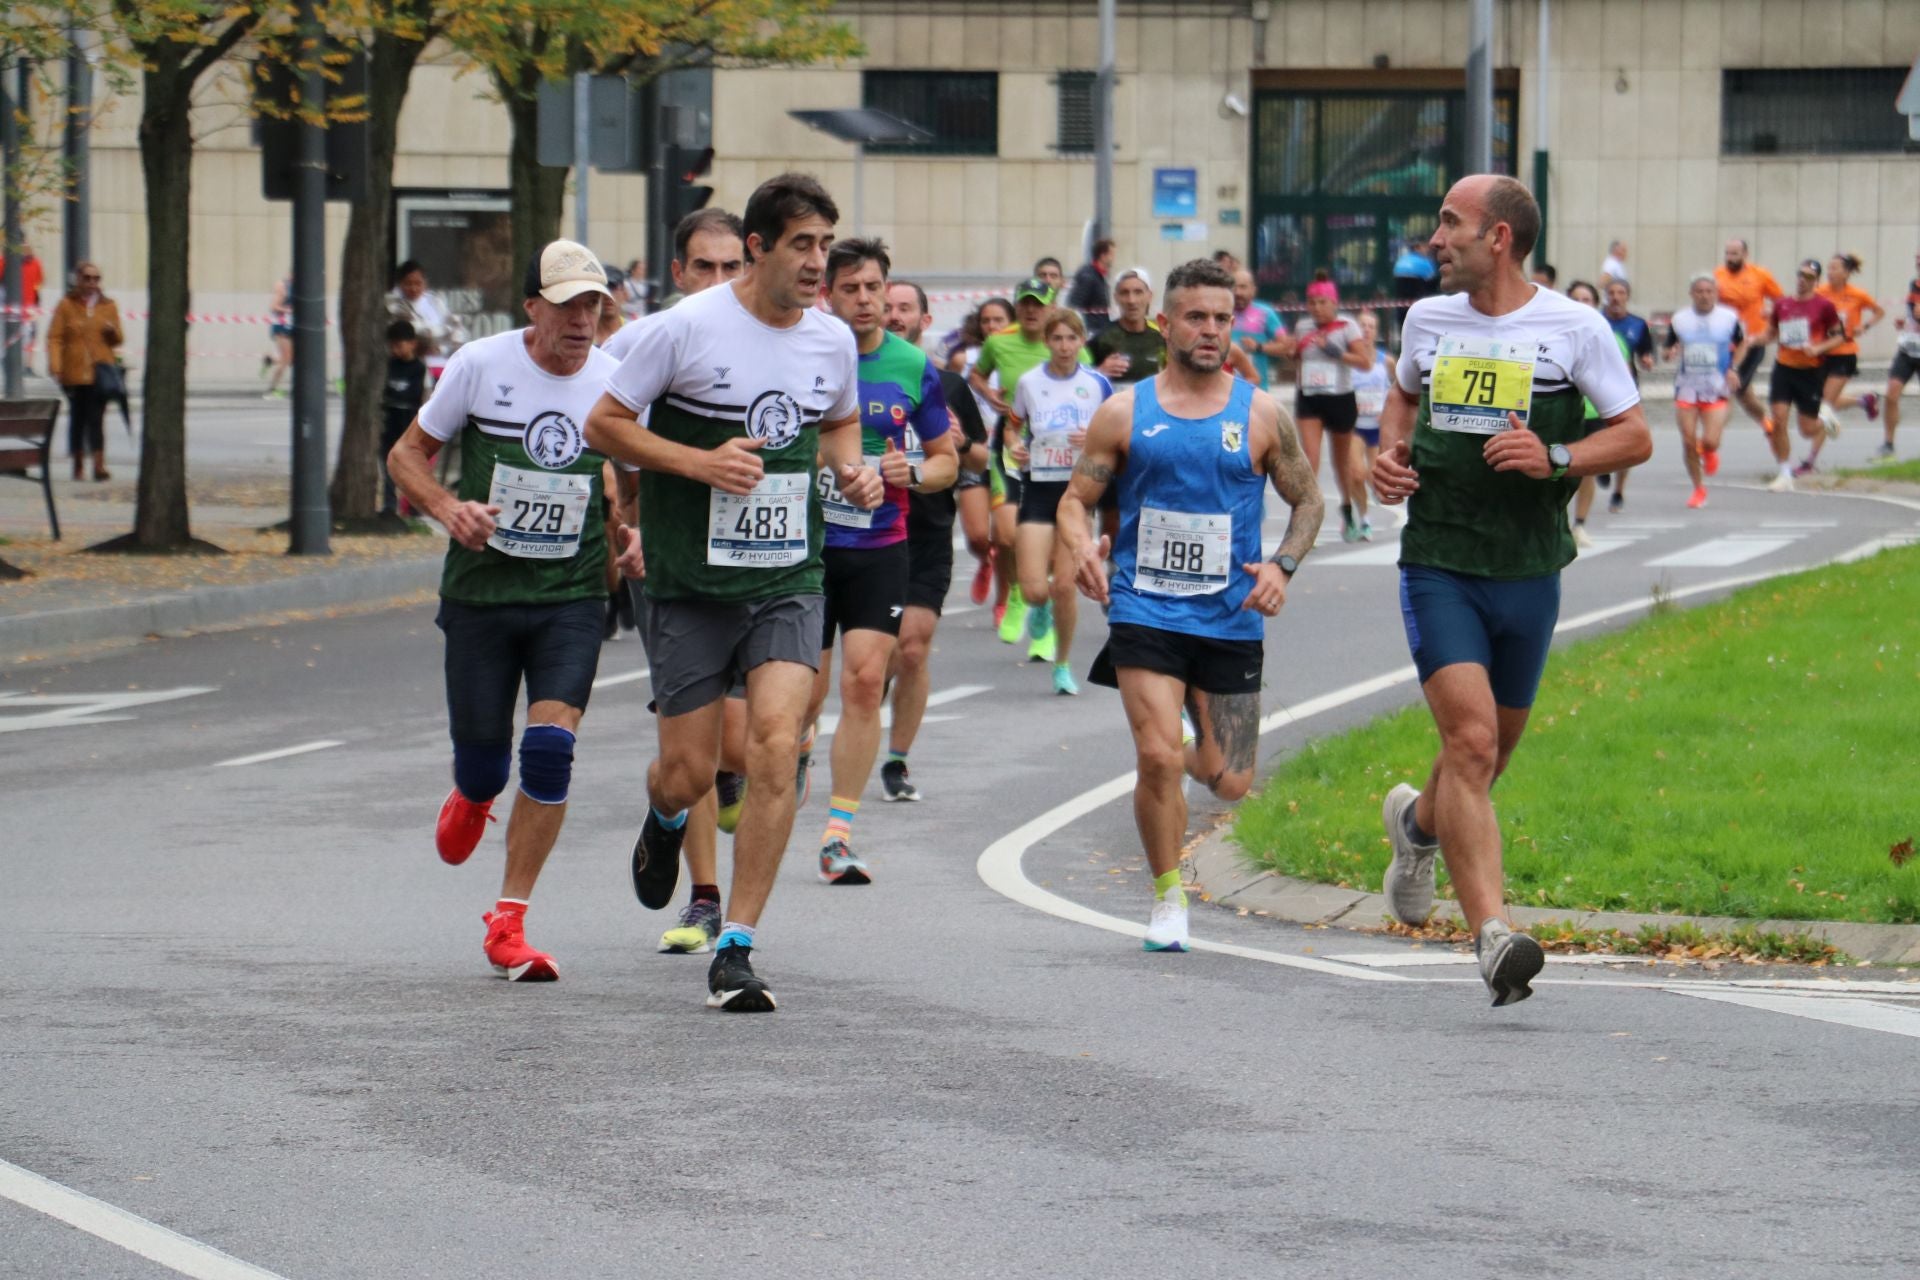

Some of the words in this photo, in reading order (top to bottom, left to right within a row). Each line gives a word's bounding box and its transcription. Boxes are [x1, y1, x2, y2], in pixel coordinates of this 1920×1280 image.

[1462, 370, 1497, 406] 79
[510, 500, 565, 534] 229
[735, 506, 788, 539] 483
[521, 543, 564, 552] HYUNDAI
[748, 552, 792, 560] HYUNDAI
[1162, 540, 1204, 572] 198
[1168, 582, 1212, 591] HYUNDAI
